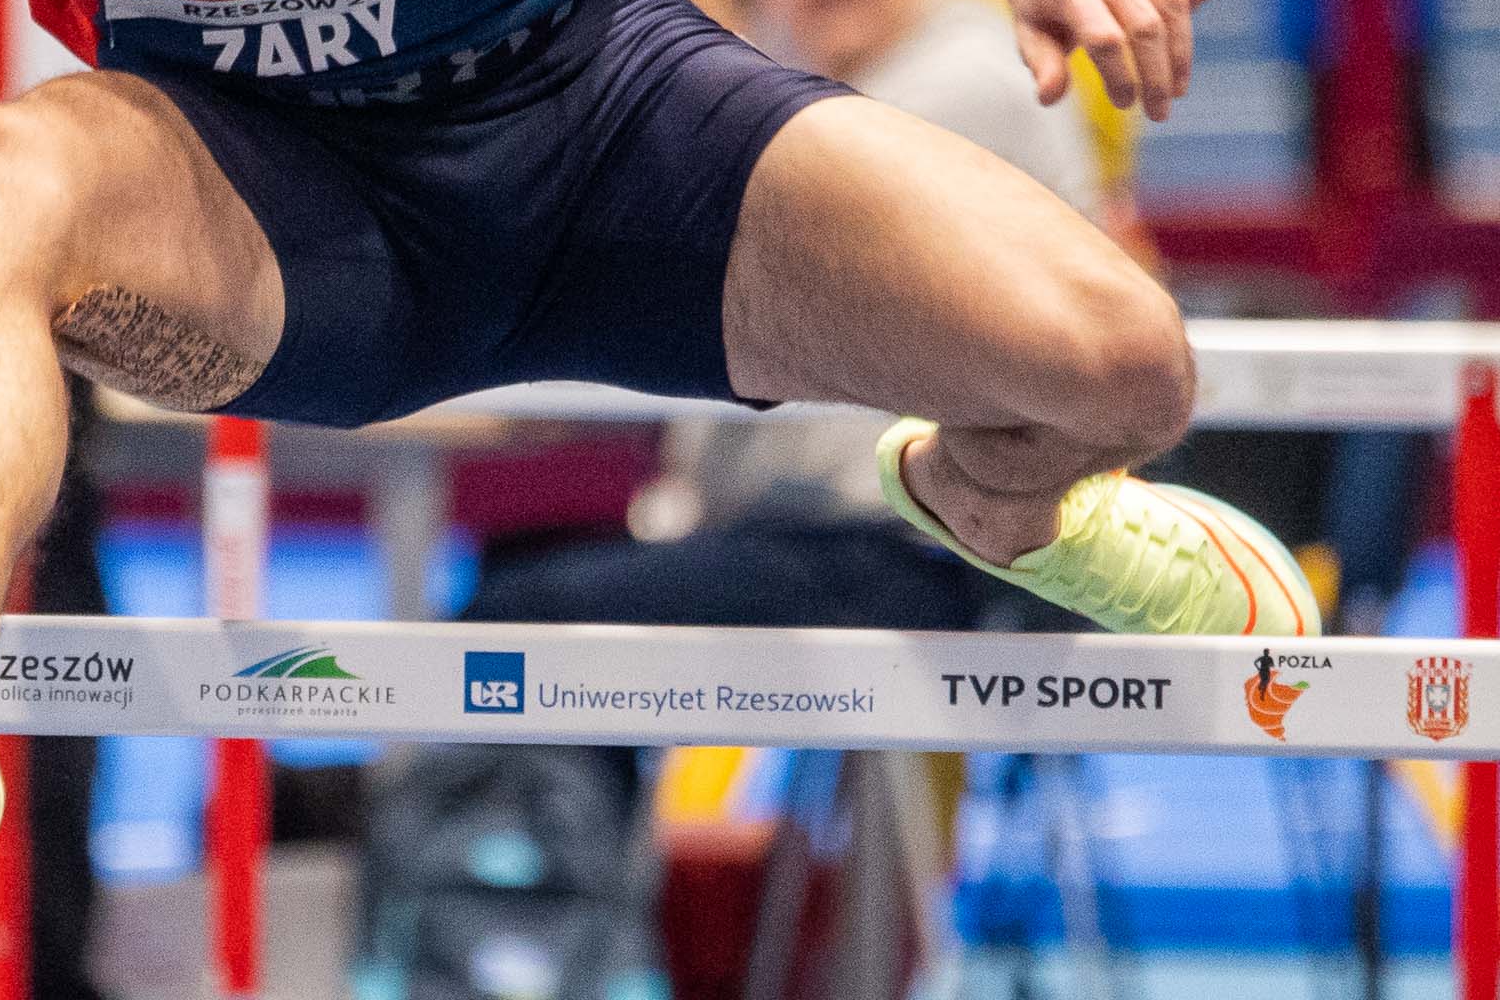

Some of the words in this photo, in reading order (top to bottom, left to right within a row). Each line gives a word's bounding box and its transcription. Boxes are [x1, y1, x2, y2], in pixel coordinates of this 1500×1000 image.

[1278, 655, 1332, 670] POZLA
[49, 685, 133, 709] innowacji
[200, 683, 397, 704] PODKARPACKIE
[539, 682, 706, 716] Uniwersytet
[717, 685, 875, 712] Rzeszowski
[941, 674, 1025, 706] TVP
[1037, 676, 1171, 710] SPORT
